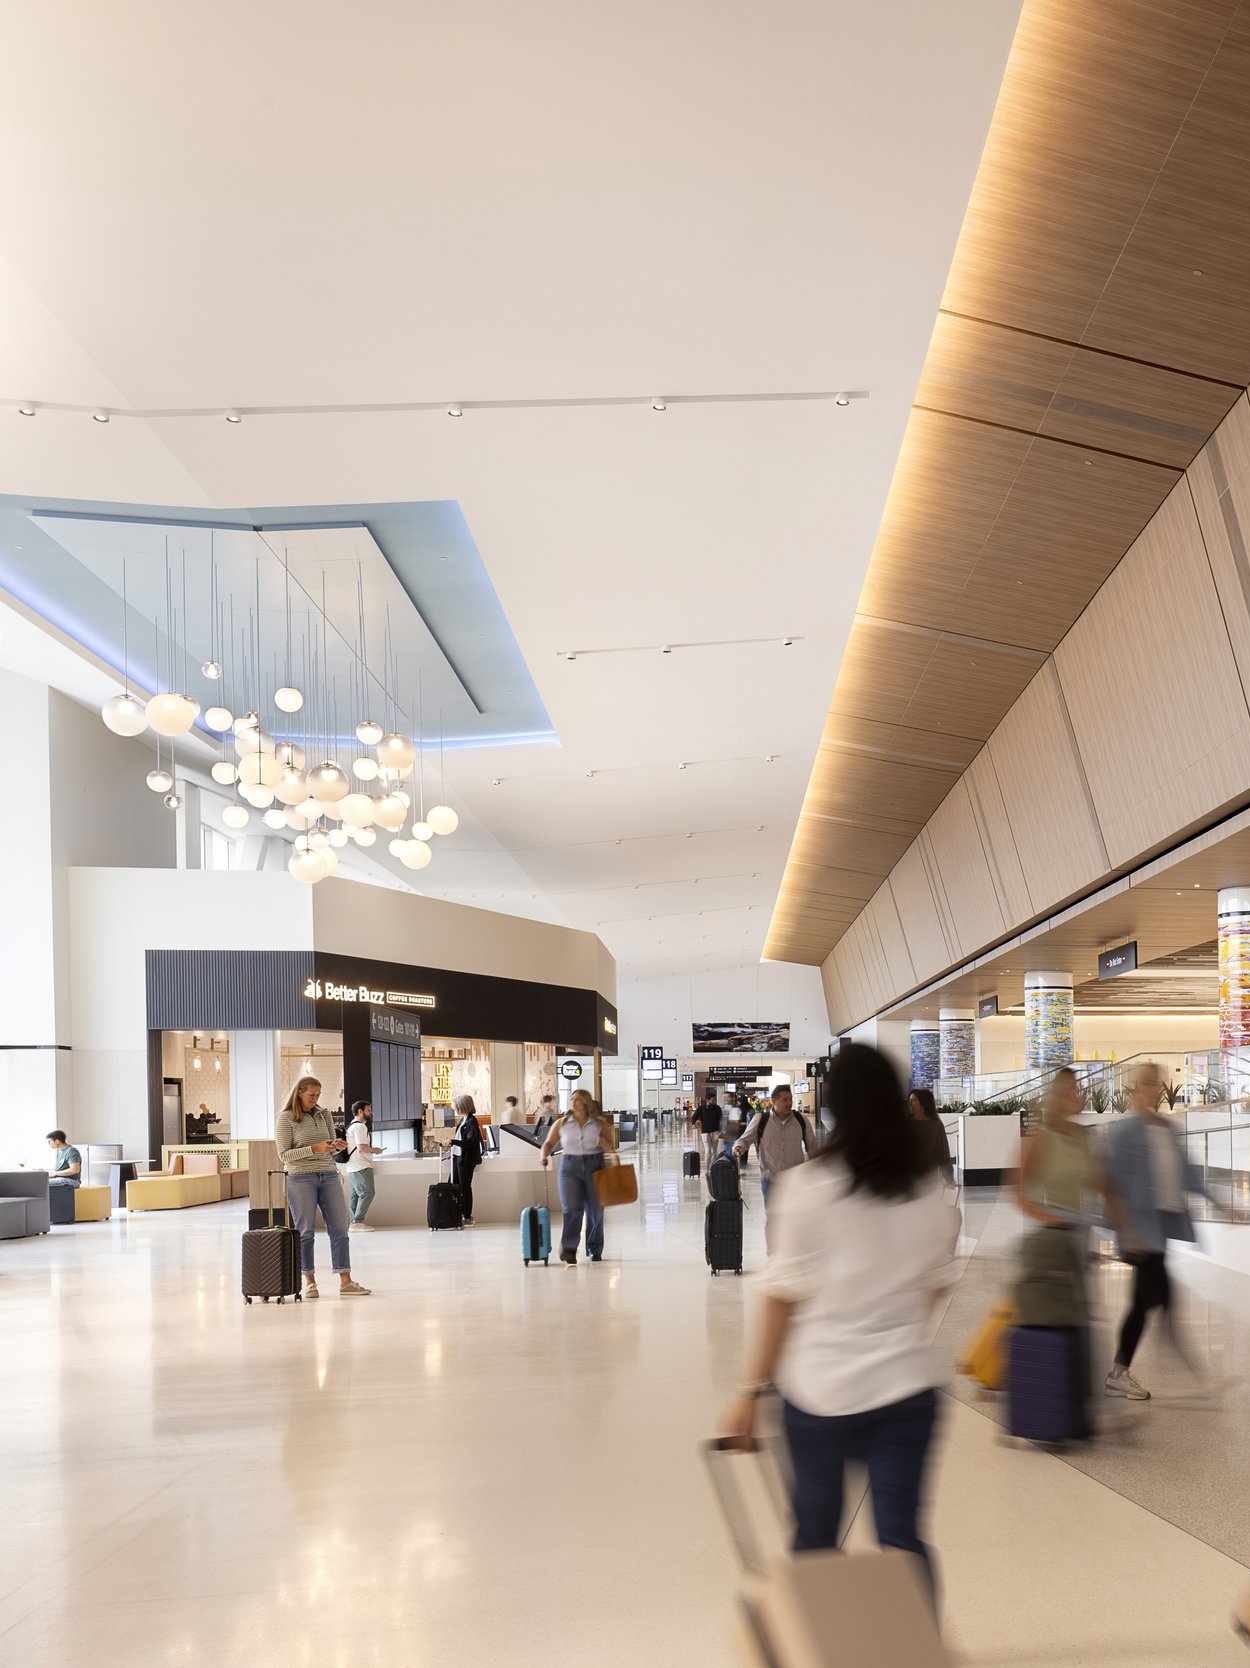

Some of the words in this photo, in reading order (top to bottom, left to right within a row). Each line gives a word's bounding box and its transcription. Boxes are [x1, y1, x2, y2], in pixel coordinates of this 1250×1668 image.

[325, 982, 358, 1002] Better
[359, 985, 385, 1005] Buzz
[389, 994, 408, 1003] COFFEE
[408, 996, 433, 1005] ROASTERS
[643, 1049, 662, 1059] 119
[662, 1060, 676, 1068] 118
